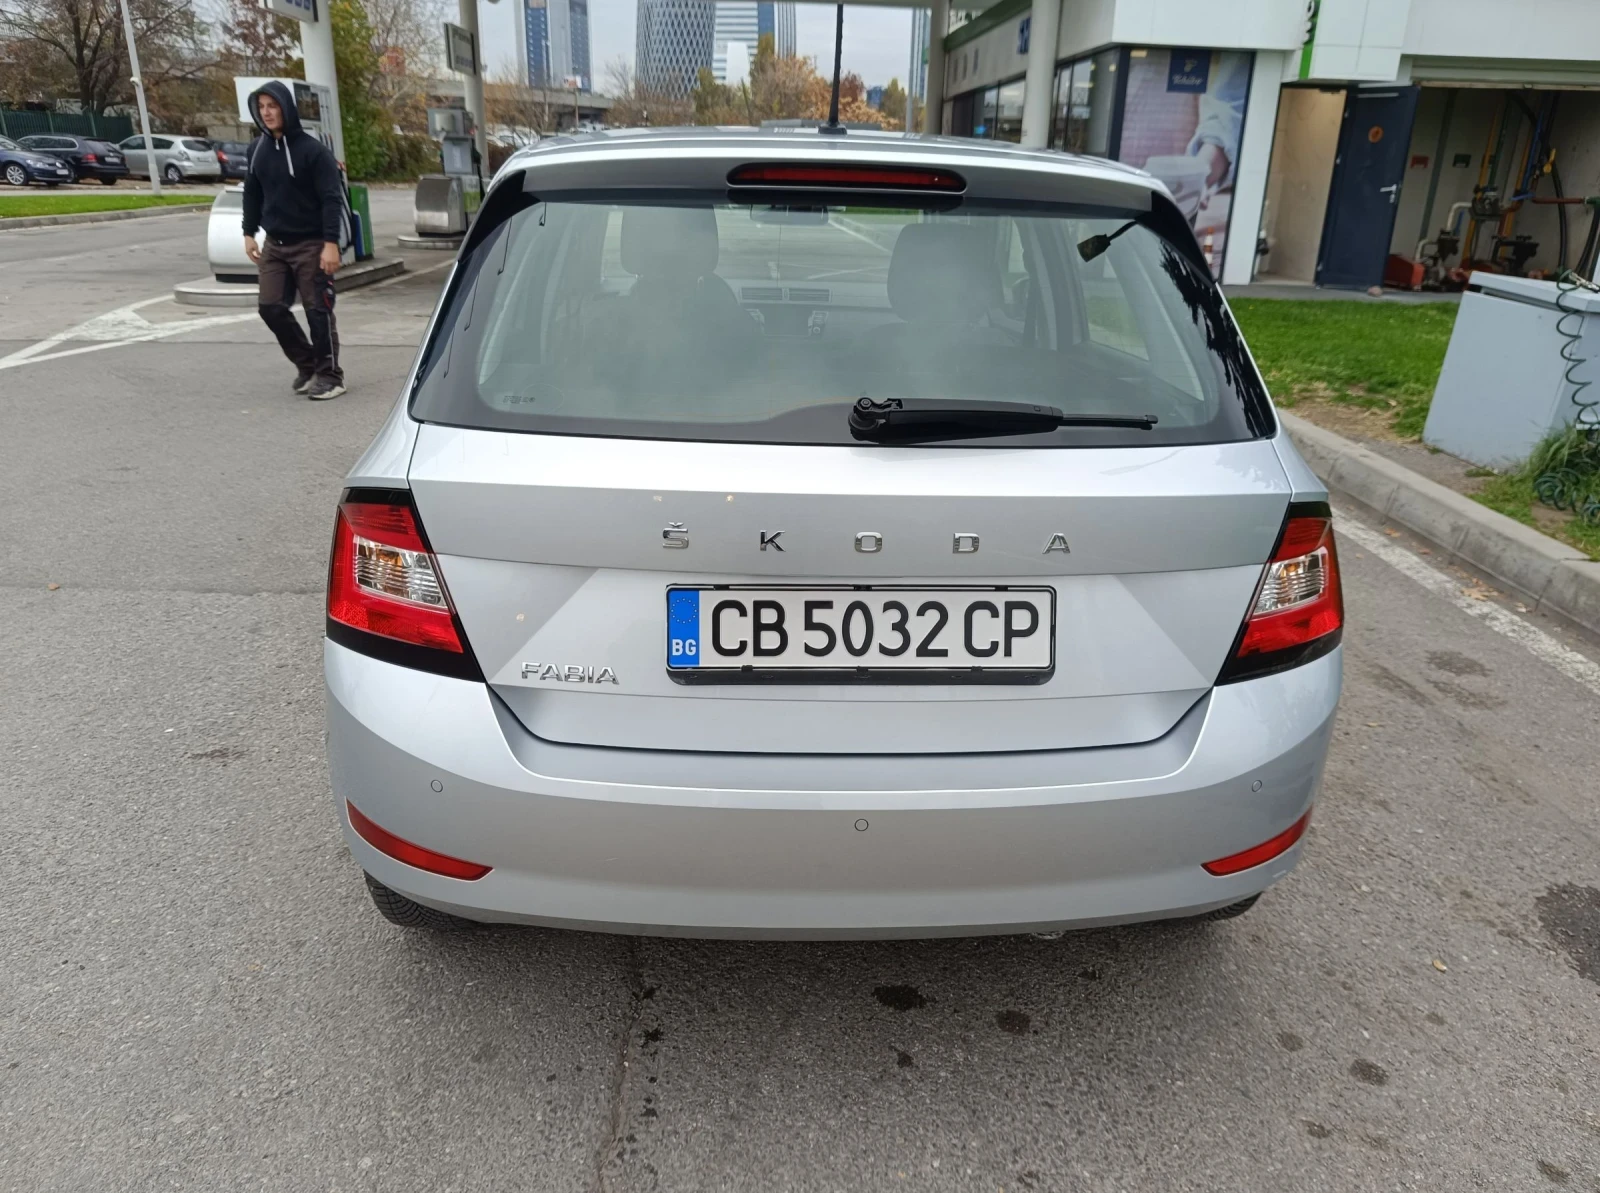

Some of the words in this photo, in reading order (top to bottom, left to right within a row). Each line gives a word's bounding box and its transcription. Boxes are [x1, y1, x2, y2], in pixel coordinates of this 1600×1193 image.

[662, 522, 1071, 555] ŠKODA
[711, 599, 789, 657] CB
[804, 600, 949, 657] 5032
[963, 600, 1039, 657] CP
[671, 638, 697, 656] BG
[521, 661, 620, 685] FABIA
